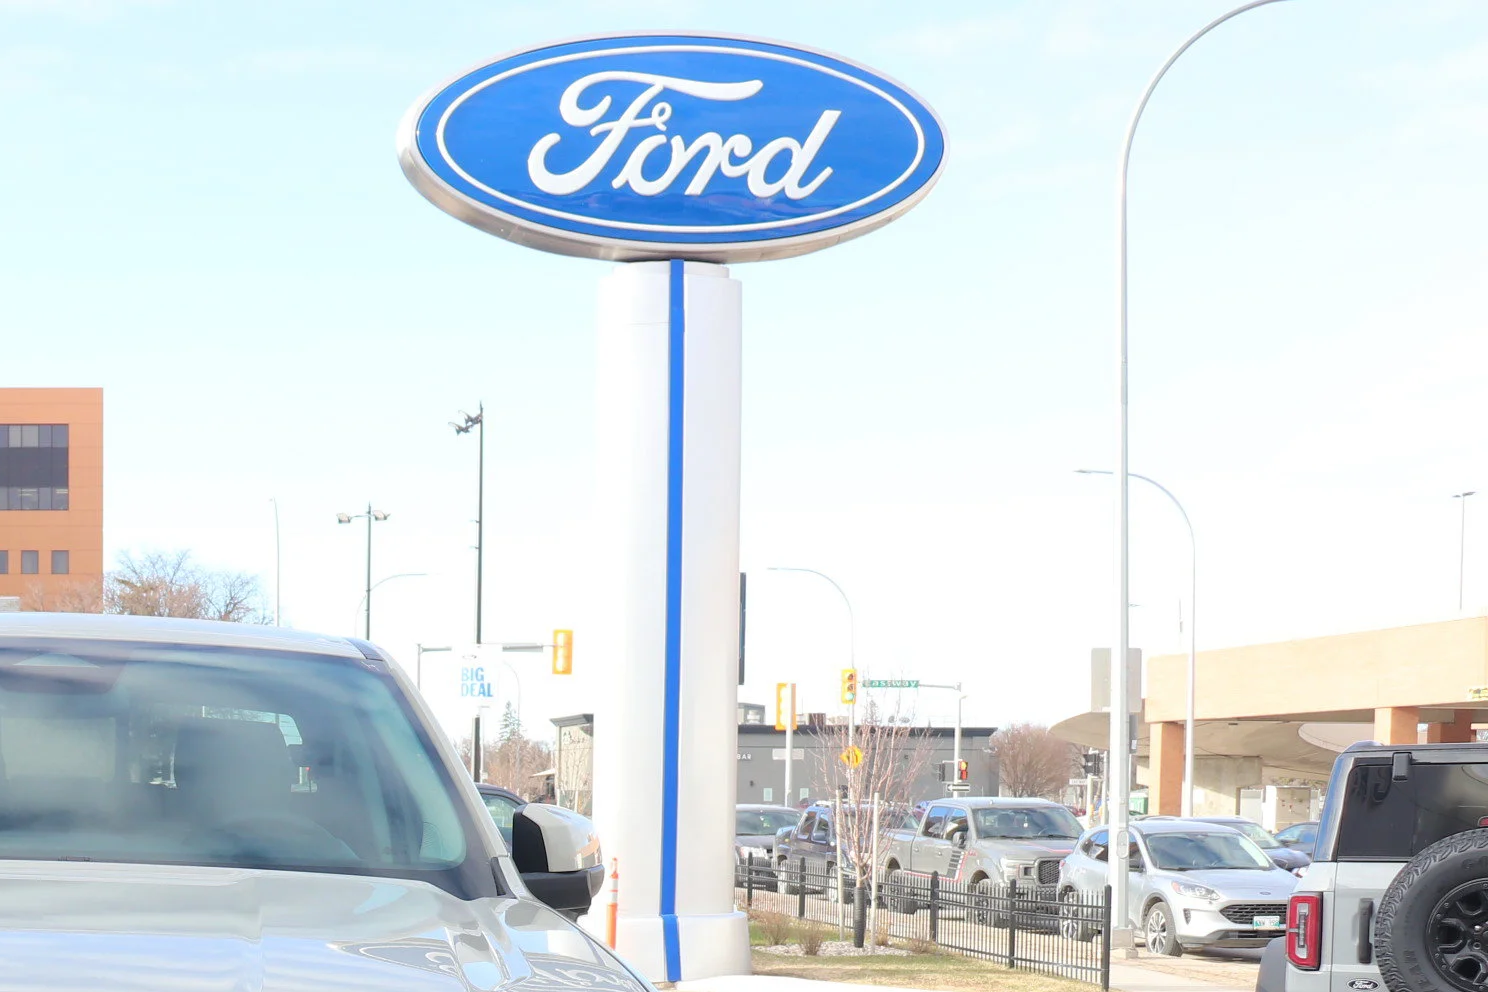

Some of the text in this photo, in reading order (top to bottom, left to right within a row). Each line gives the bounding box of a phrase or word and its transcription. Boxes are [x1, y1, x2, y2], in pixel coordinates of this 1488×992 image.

[527, 70, 842, 200] Ford
[461, 667, 485, 681] BIG
[461, 683, 493, 697] DEAL
[1353, 980, 1373, 989] Ford
